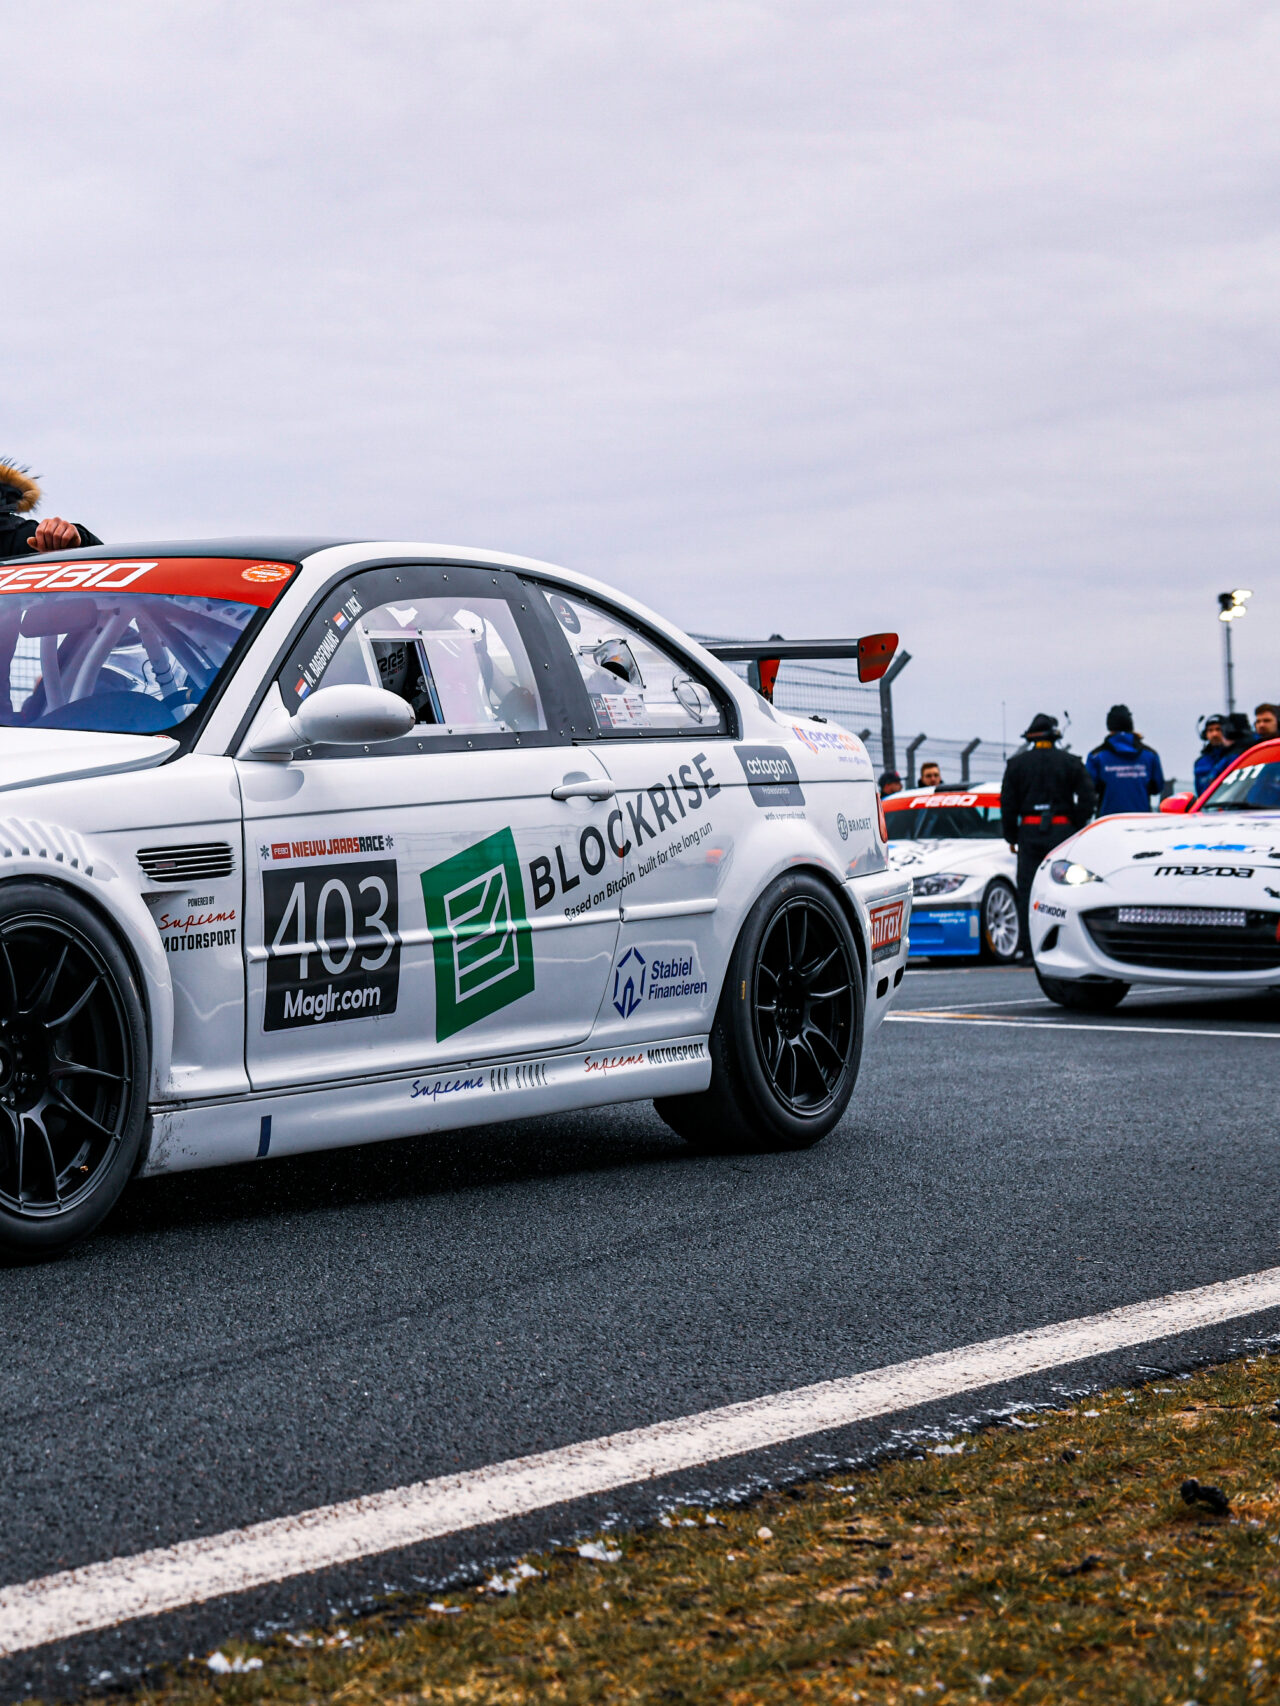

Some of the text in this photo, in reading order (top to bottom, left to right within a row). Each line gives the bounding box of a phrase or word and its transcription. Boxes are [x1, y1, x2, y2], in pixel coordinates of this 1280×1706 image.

[746, 757, 793, 781] octagon
[910, 794, 978, 808] FEBO
[529, 752, 721, 911] BLOCKRISE
[848, 818, 872, 831] BRACKET
[274, 835, 385, 858] FEBO NIEUWJAARSRACE
[564, 822, 713, 921] Based on Bitcoin built for the long run
[188, 895, 215, 908] POWERED BY
[159, 909, 236, 933] Supreme
[272, 876, 393, 980] 403
[163, 929, 237, 952] MOTORSPORT
[651, 956, 693, 980] Stabiel
[648, 980, 708, 1000] Financieren
[283, 985, 381, 1021] Maglr.com
[584, 1042, 706, 1075] Supreme MOTORSPORT
[410, 1075, 484, 1101] Supreme
